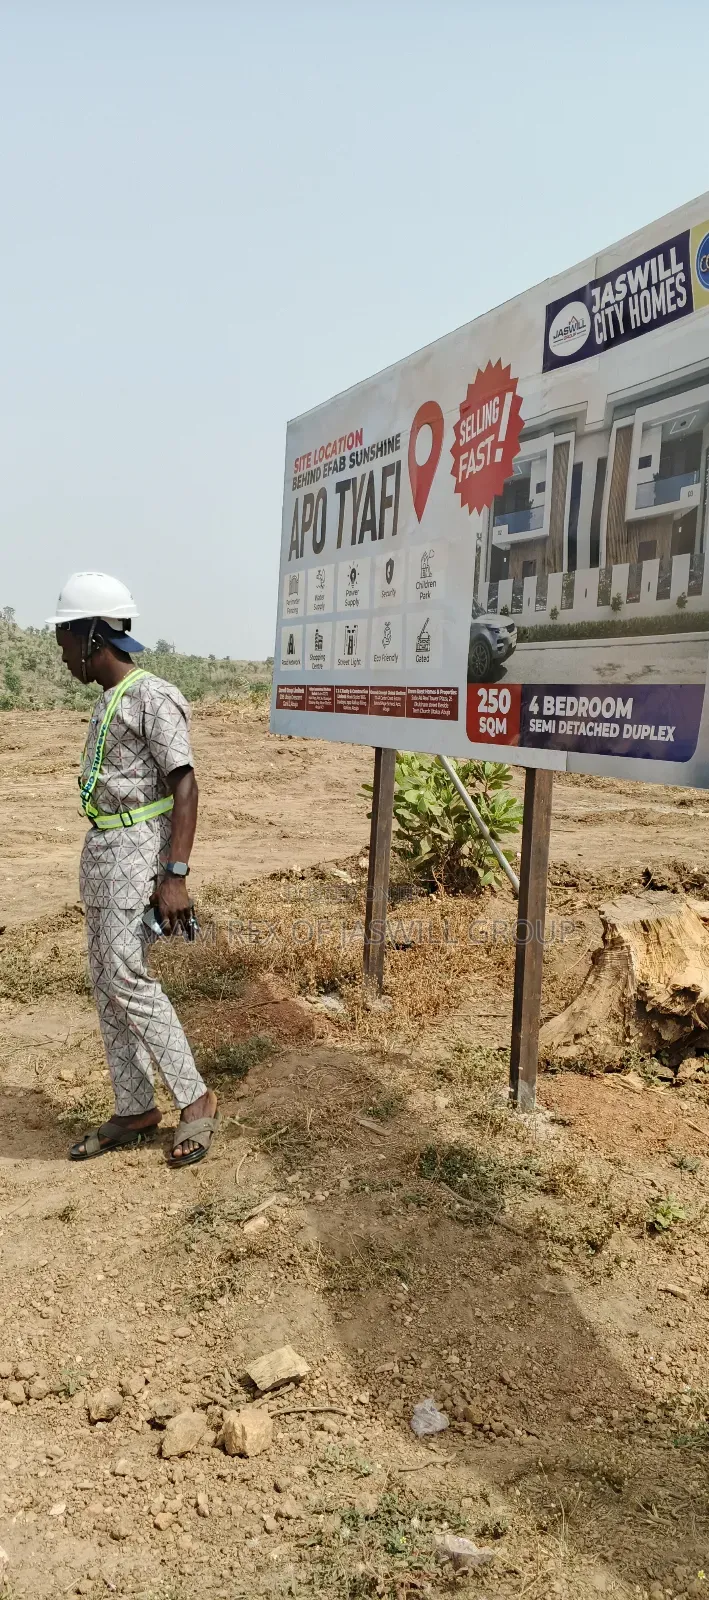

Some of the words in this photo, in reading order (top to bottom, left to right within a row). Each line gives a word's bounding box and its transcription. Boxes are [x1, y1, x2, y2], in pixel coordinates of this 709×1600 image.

[591, 247, 684, 313] JASWILL
[594, 300, 625, 345] CITY
[628, 271, 687, 329] HOMES
[553, 317, 587, 340] JASWILL
[460, 396, 500, 447] SELLING
[291, 466, 322, 491] BEHIND
[322, 455, 347, 479] EFAB
[348, 432, 401, 469] SUNSHINE
[293, 451, 312, 474] SITE
[313, 427, 364, 466] LOCATION
[288, 486, 328, 562] APO
[335, 459, 402, 550] TYAFI
[345, 589, 360, 597] Power
[415, 580, 437, 590] Children
[419, 590, 432, 600] Park
[344, 598, 360, 607] Supply
[309, 653, 326, 662] Shopping
[337, 658, 350, 666] Street
[350, 657, 361, 667] Light
[381, 653, 399, 663] Friendly
[477, 687, 512, 714] 250
[528, 695, 539, 715] 4
[543, 695, 634, 719] BEDROOM
[479, 716, 507, 737] SQM
[529, 718, 555, 734] SEMI
[558, 721, 619, 738] DETACHED
[622, 724, 676, 742] DUPLEX
